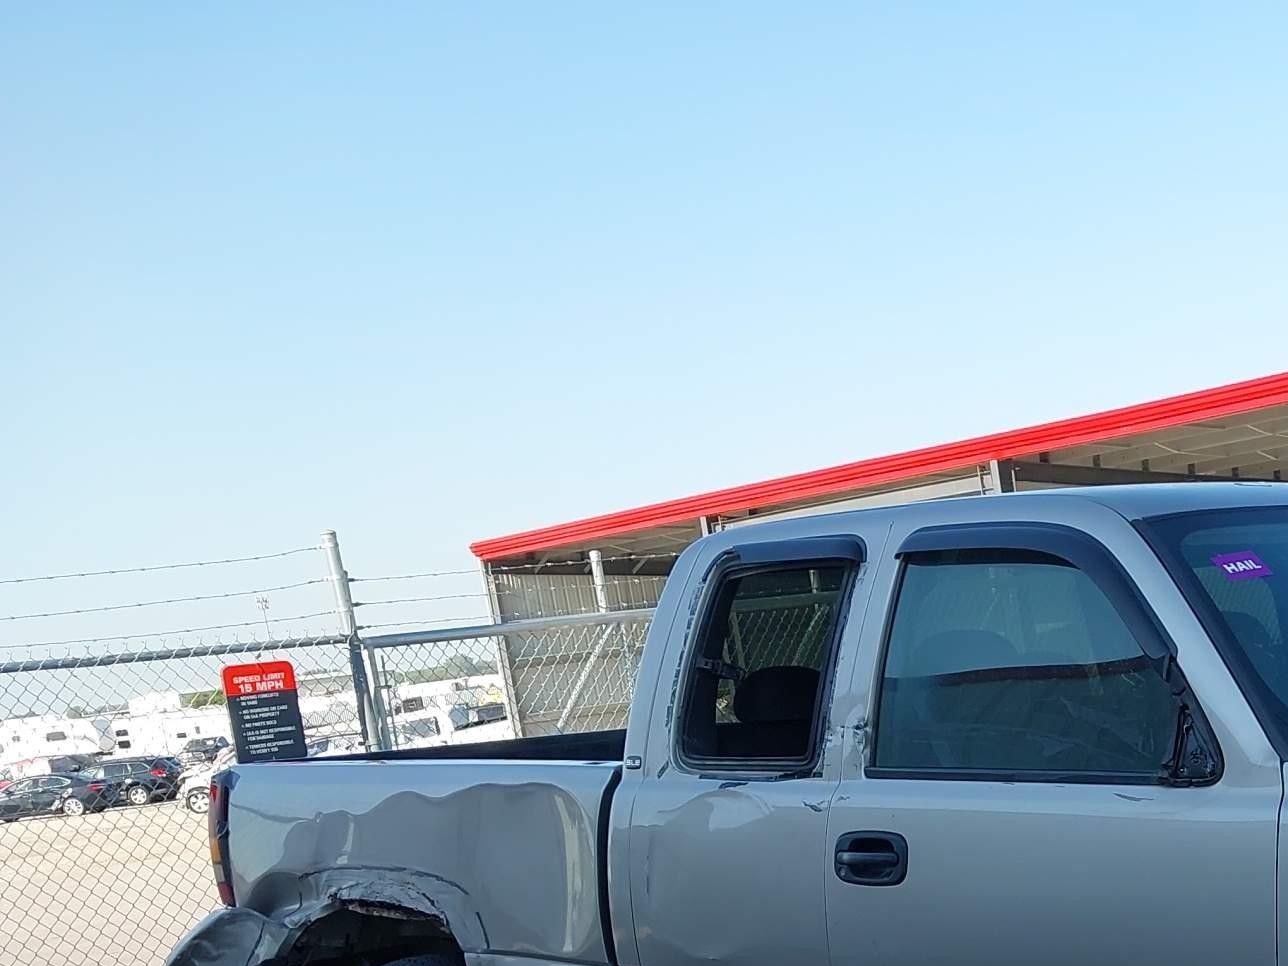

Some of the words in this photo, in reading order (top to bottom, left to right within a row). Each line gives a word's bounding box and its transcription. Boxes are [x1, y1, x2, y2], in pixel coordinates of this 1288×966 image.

[1222, 559, 1262, 574] HAIL
[232, 674, 260, 684] SPEED
[262, 672, 285, 681] LIMIT
[239, 683, 253, 694] 15
[256, 680, 283, 691] MPH
